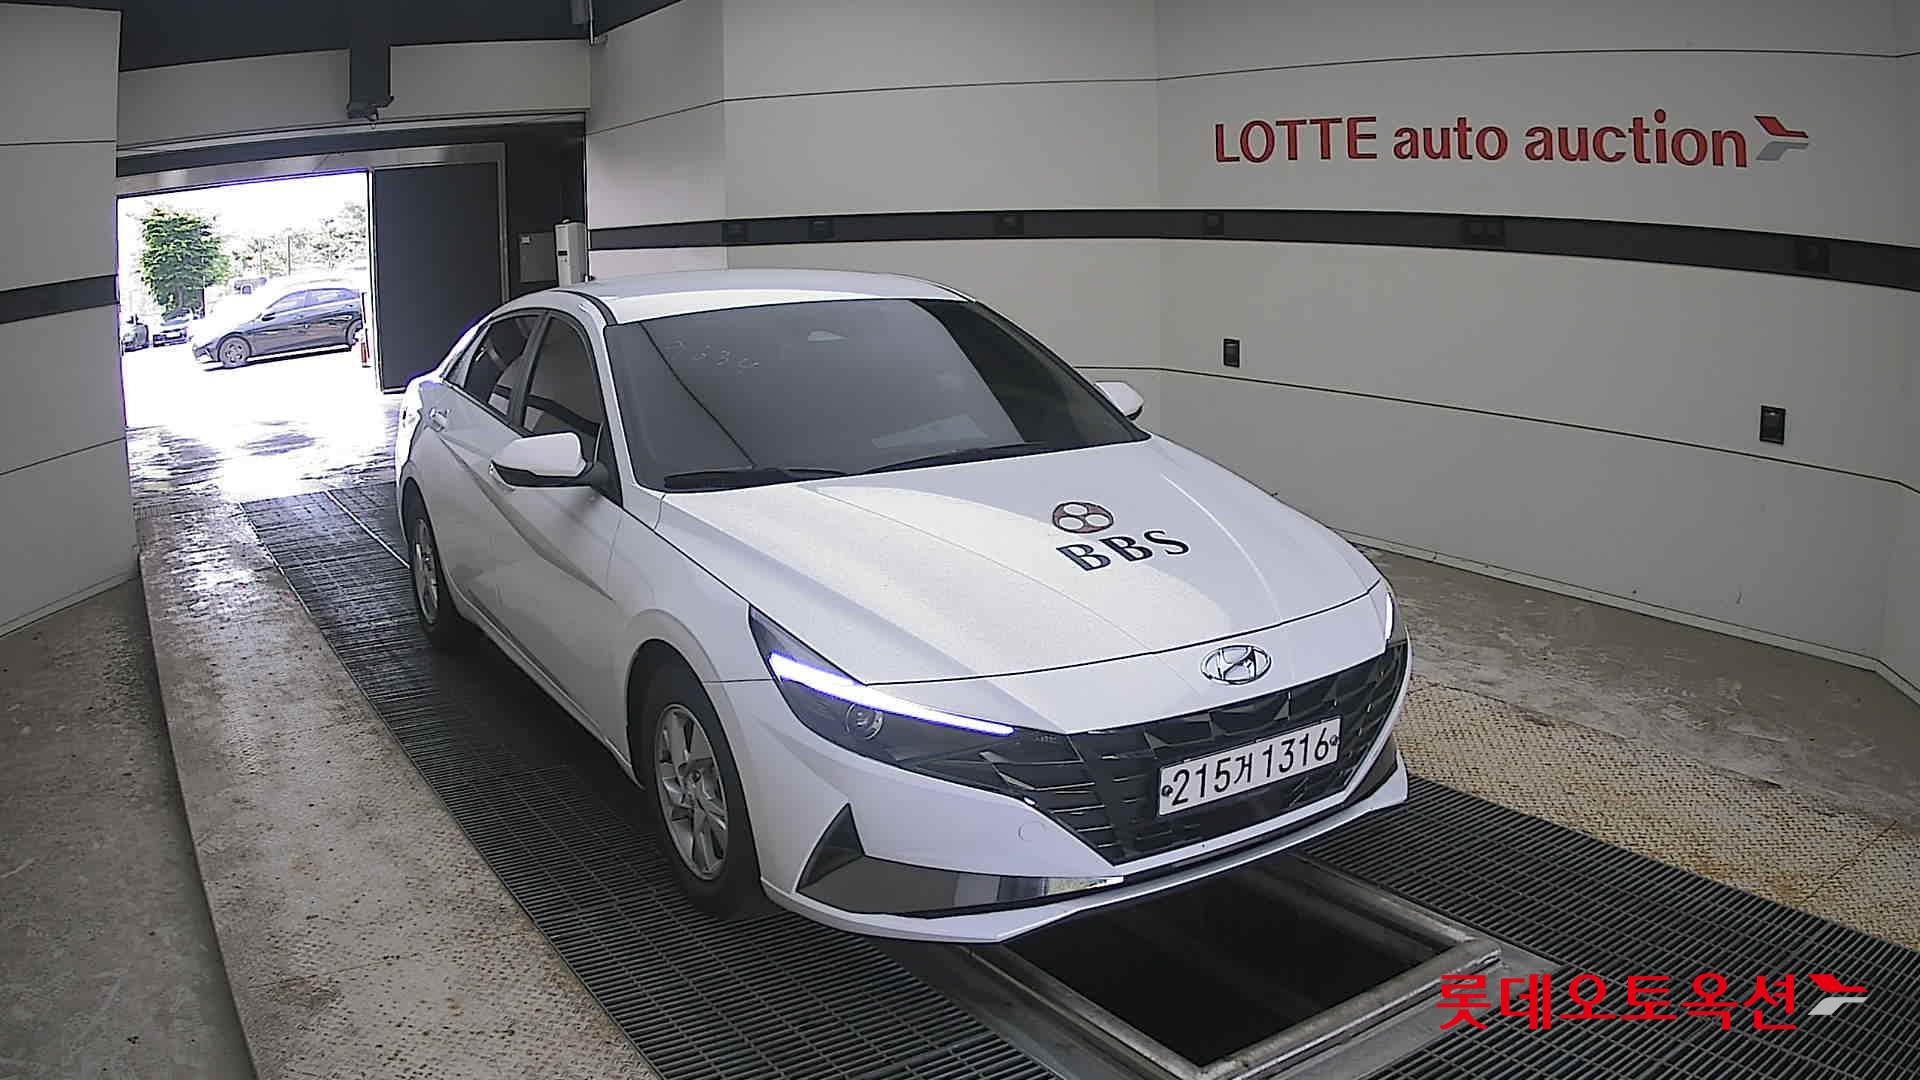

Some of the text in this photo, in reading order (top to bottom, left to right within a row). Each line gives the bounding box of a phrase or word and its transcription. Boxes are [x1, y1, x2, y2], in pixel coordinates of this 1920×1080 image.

[1214, 109, 1748, 168] LOTTE auto auction
[1056, 530, 1189, 571] BBS
[1171, 728, 1330, 806] 215거 1316
